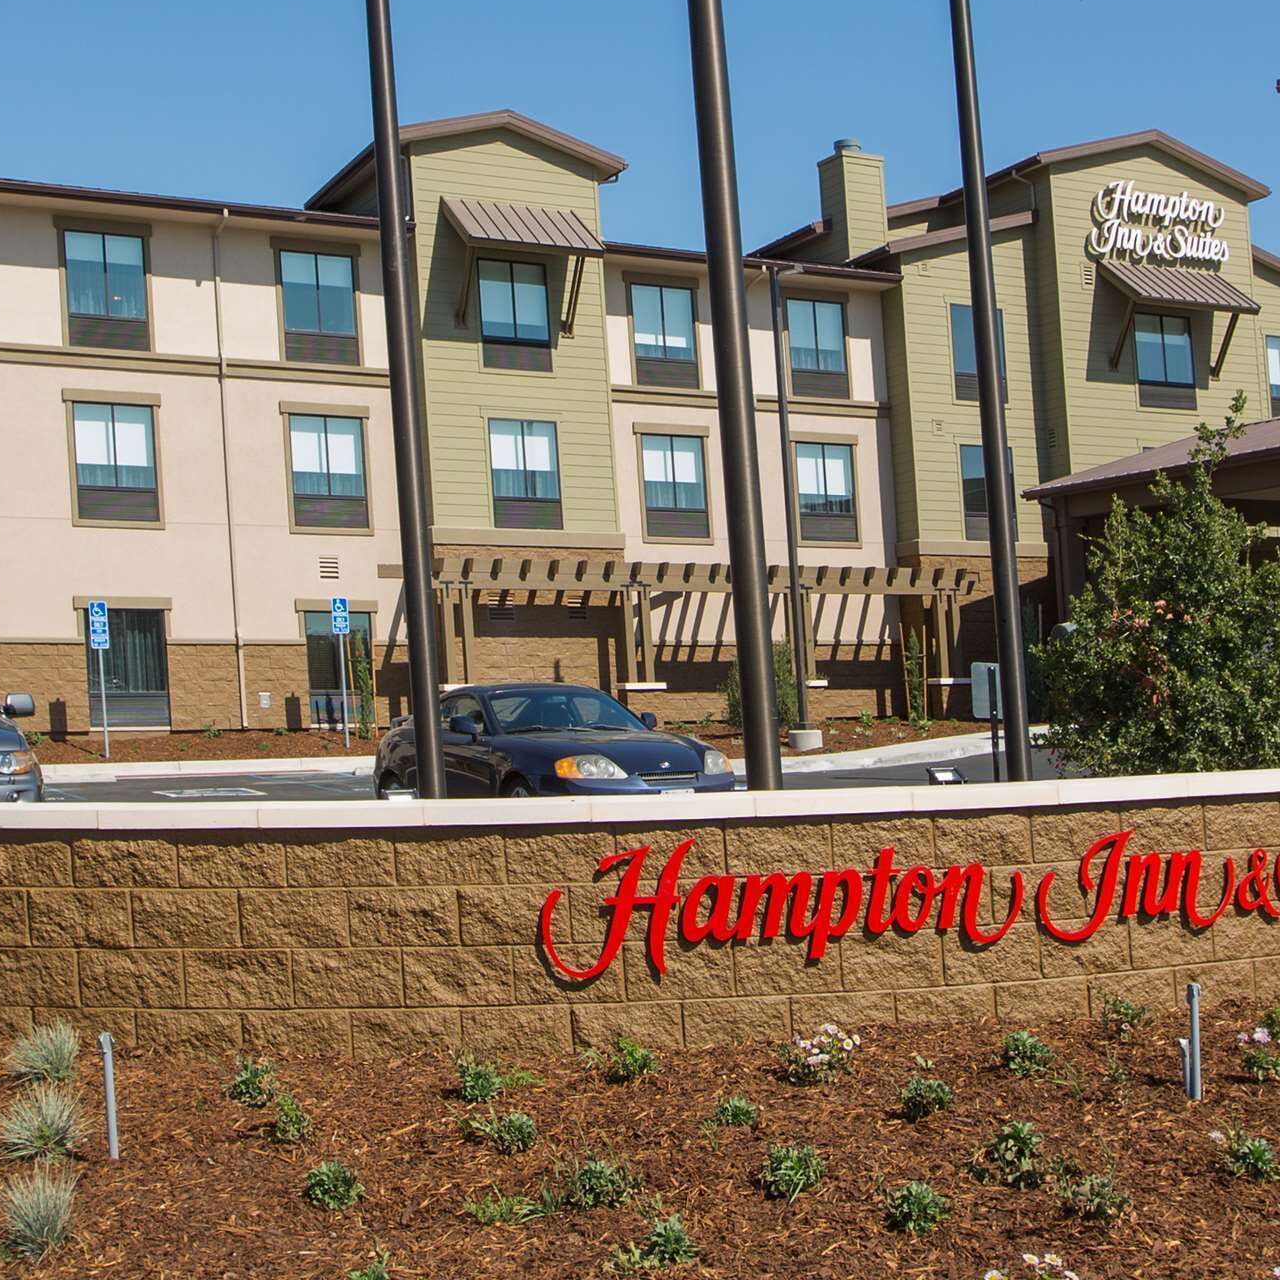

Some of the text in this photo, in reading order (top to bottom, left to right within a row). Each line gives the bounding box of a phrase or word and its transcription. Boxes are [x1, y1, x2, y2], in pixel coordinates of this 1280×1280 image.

[1097, 180, 1224, 228] Hampton
[1091, 220, 1230, 262] Inn & Suites
[540, 836, 1026, 980] Hampton
[1038, 828, 1235, 941] Inn
